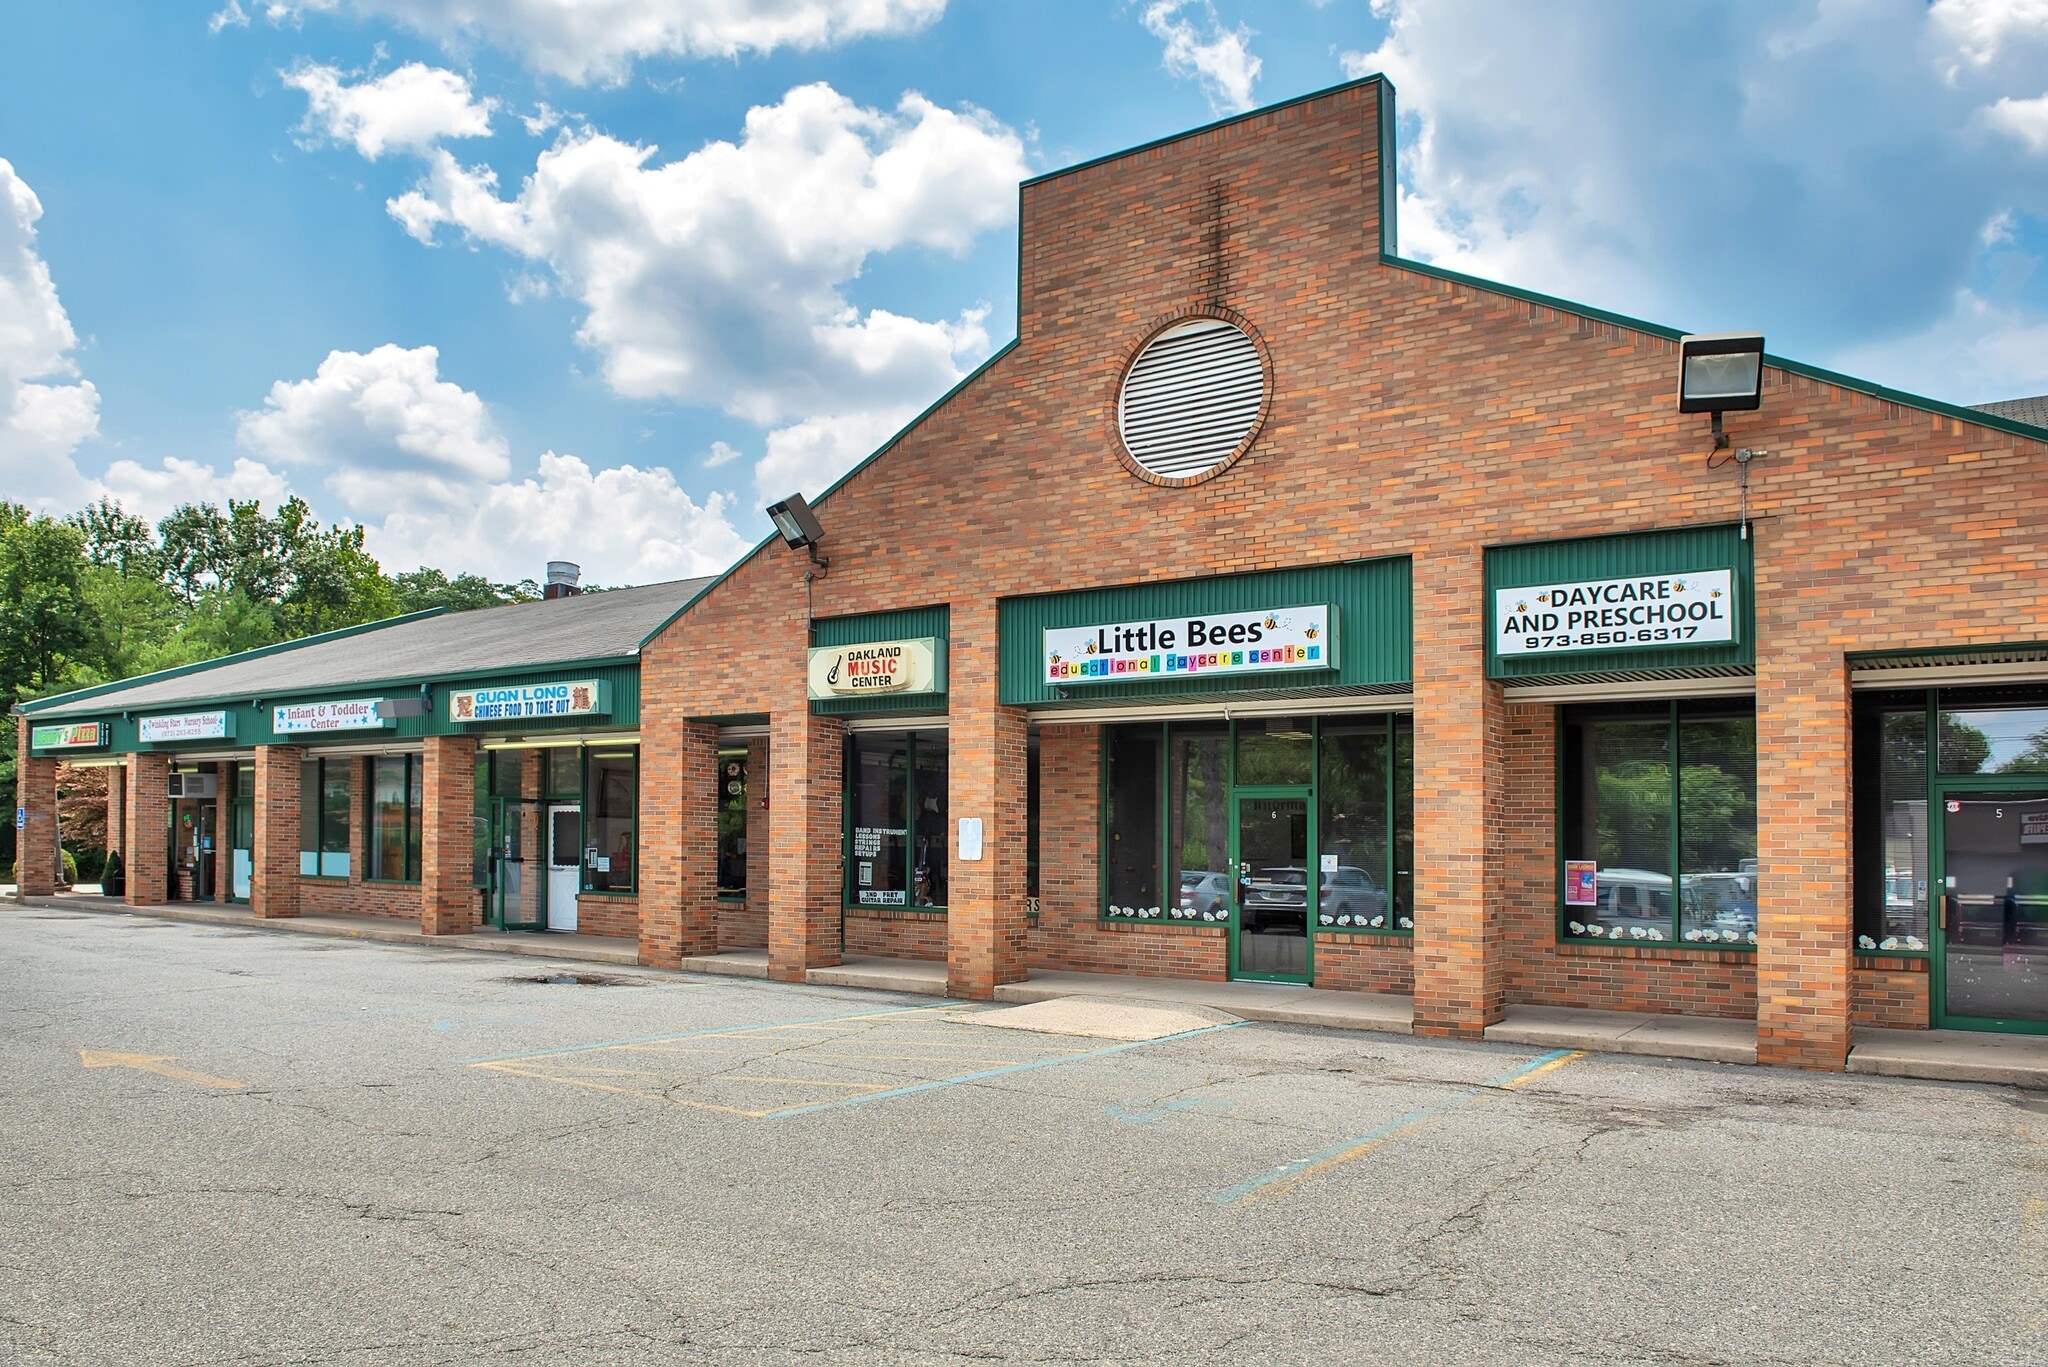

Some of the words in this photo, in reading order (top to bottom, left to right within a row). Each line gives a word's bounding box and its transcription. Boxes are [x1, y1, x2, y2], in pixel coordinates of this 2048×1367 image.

[1551, 580, 1670, 608] DAYCARE
[1503, 612, 1560, 634] AND
[1568, 600, 1723, 630] PRESCHOOL
[1098, 622, 1176, 654] Little
[1187, 620, 1263, 648] Bees
[1525, 626, 1699, 649] 973-850-6317
[848, 646, 901, 661] OAKLAND
[1050, 655, 1158, 677] educational
[1166, 652, 1242, 669] daycare
[1250, 646, 1316, 661] center
[848, 658, 897, 677] MUSIC
[852, 675, 892, 688] CENTER
[475, 689, 519, 704] GUAN
[522, 685, 568, 701] LONG
[287, 708, 316, 720] Infant
[318, 705, 326, 717] &
[331, 703, 369, 716] Toddler
[474, 703, 503, 718] CHINESE
[504, 702, 522, 717] FOOD
[525, 702, 534, 716] TO
[536, 700, 553, 714] TAKE
[555, 699, 571, 713] OUT
[170, 718, 181, 727] Stars
[184, 717, 201, 728] Nursery
[202, 715, 218, 725] School
[310, 718, 340, 729] Center
[71, 726, 95, 742] Pizza
[1271, 811, 1277, 819] 6
[1995, 808, 2003, 819] 5
